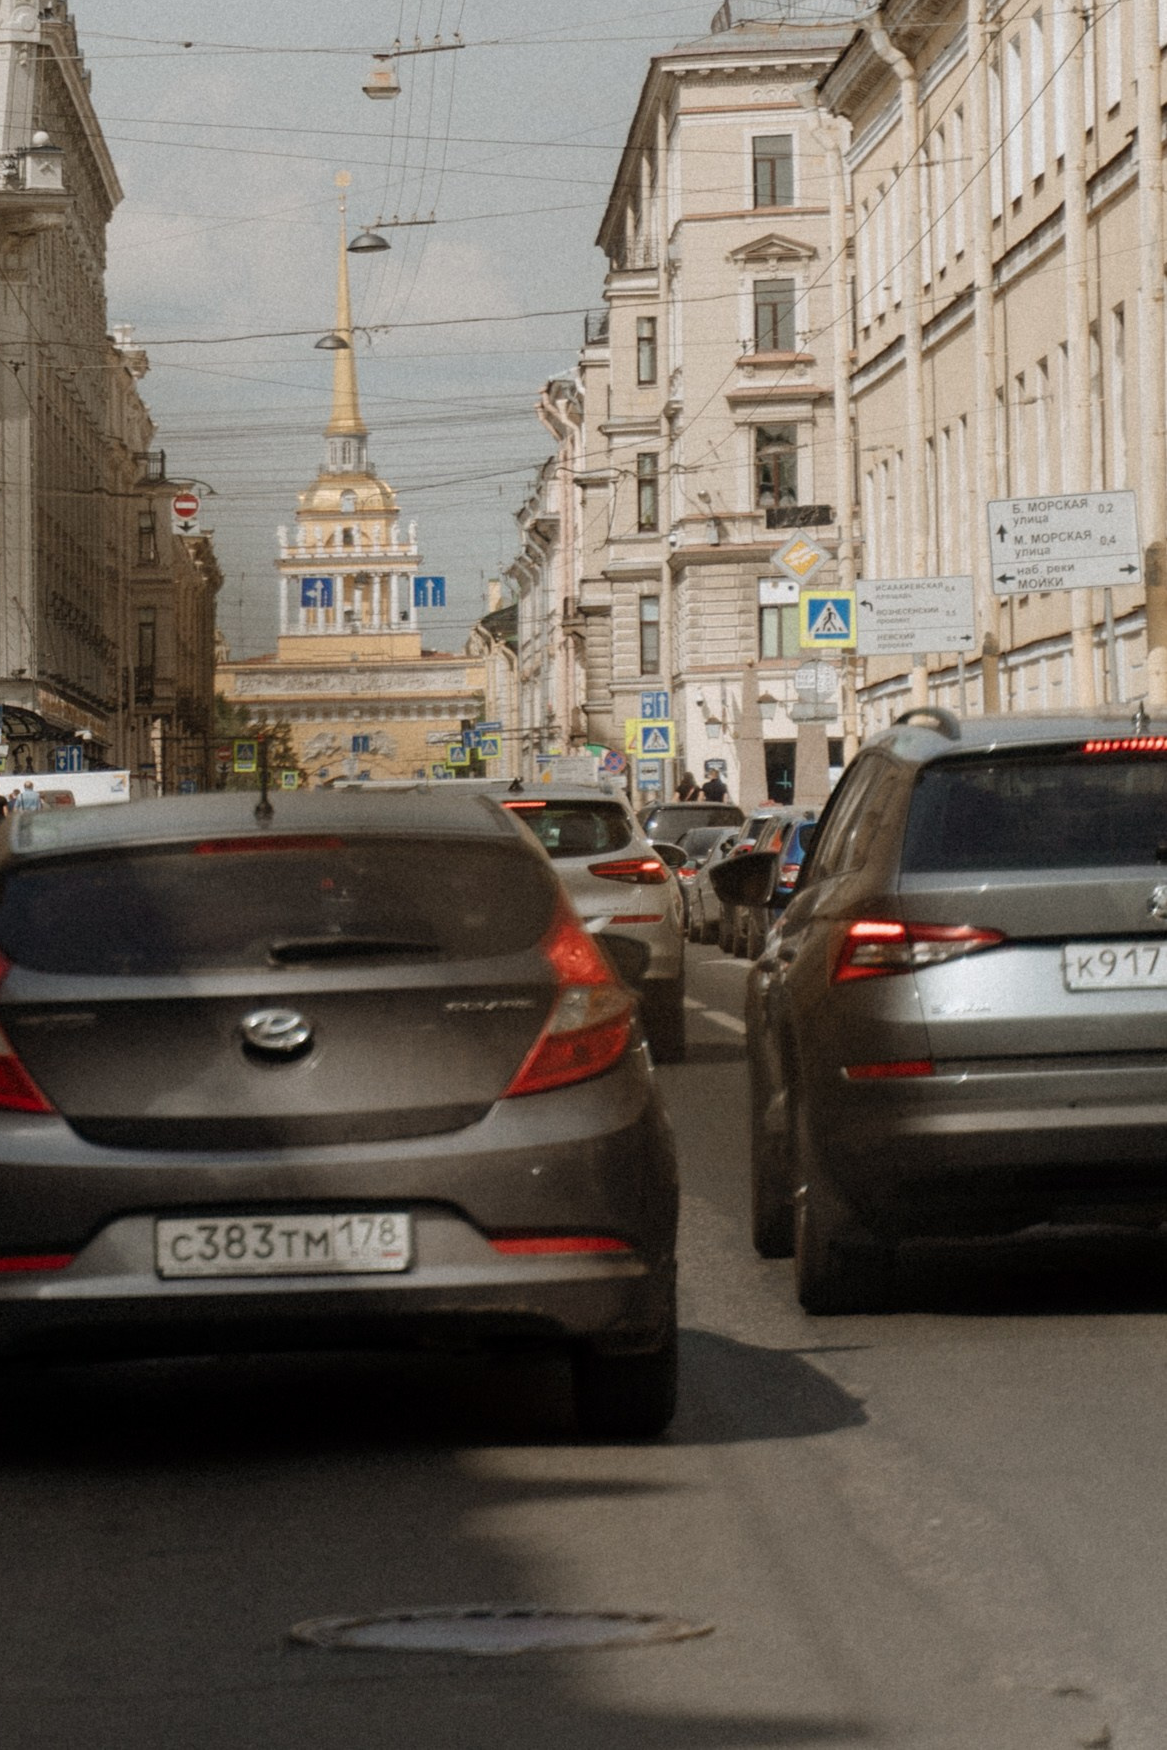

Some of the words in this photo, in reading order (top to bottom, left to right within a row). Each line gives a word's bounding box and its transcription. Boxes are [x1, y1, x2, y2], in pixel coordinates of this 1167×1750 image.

[1012, 503, 1024, 514] Б.
[1028, 499, 1088, 512] МОРСКАЯ
[1098, 503, 1114, 514] 0,2
[1013, 514, 1049, 527] улица
[1014, 535, 1027, 545] М.
[1031, 530, 1092, 544] МОРСКАЯ
[1100, 535, 1117, 546] 0,4
[1015, 547, 1051, 559] улица
[1017, 564, 1042, 575] наб.
[1047, 563, 1075, 576] реки
[1018, 576, 1064, 590] МОЙКИ
[1077, 947, 1160, 979] К917
[171, 1221, 331, 1262] С383ТМ
